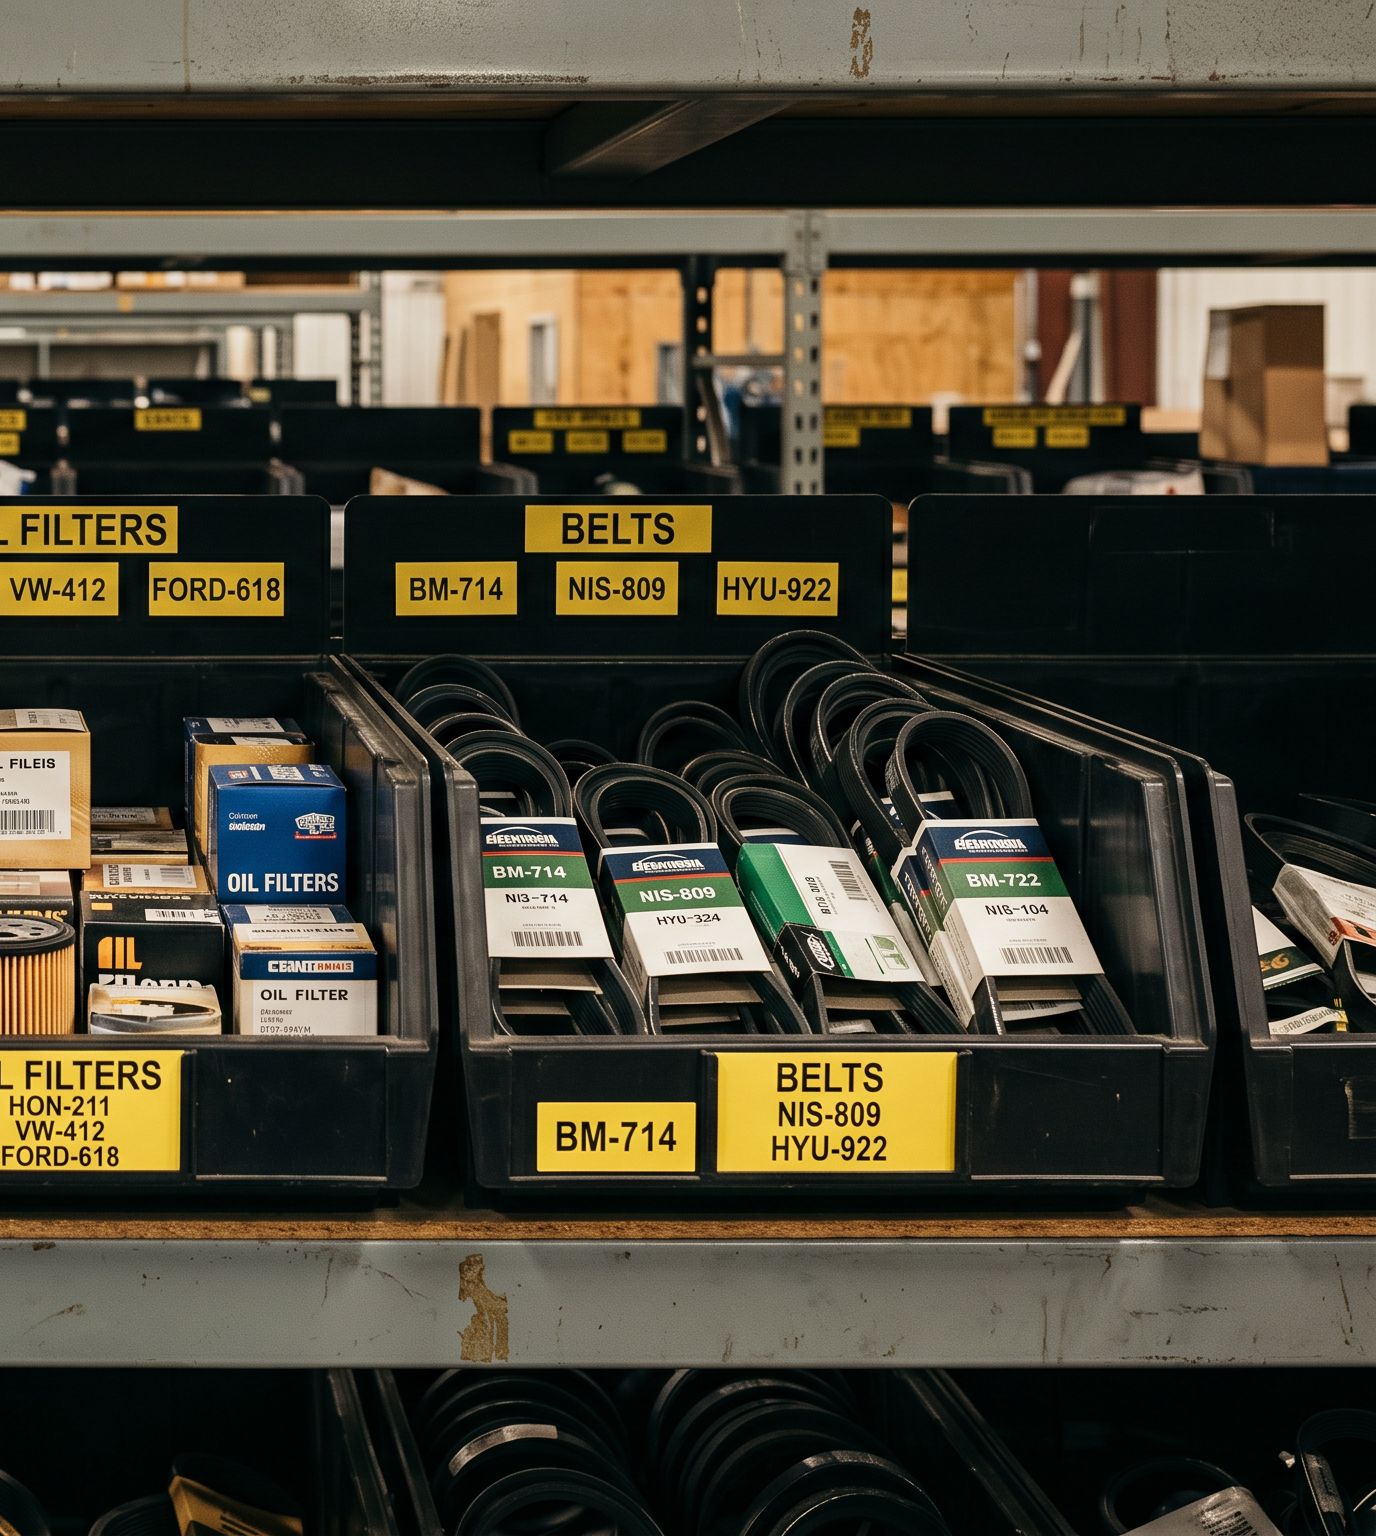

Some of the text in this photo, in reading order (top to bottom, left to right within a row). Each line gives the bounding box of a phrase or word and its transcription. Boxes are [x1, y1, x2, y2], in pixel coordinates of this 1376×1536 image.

[21, 513, 167, 546] FILTERS
[561, 512, 675, 546] BELTS
[9, 577, 106, 602] VW-412
[153, 577, 281, 602] FORD-618
[409, 576, 504, 601] BM-714
[569, 576, 666, 601] NIS-809
[723, 576, 831, 602] HYU-922
[9, 758, 56, 770] FILEIS
[227, 872, 340, 893] OIL FILTERS
[492, 866, 567, 879] BM-714
[965, 873, 1042, 888] BM-722
[639, 886, 717, 903] NIS-809
[260, 989, 349, 1001] OIL FILTER
[25, 1060, 162, 1091] FILTERS
[776, 1062, 884, 1093] BELTS
[9, 1095, 109, 1117] HON-211
[778, 1101, 881, 1128] NIS-809
[15, 1120, 105, 1142] VW-412
[556, 1121, 677, 1152] BM-714
[1, 1145, 120, 1167] FORD-618
[771, 1135, 887, 1162] HYU-922
